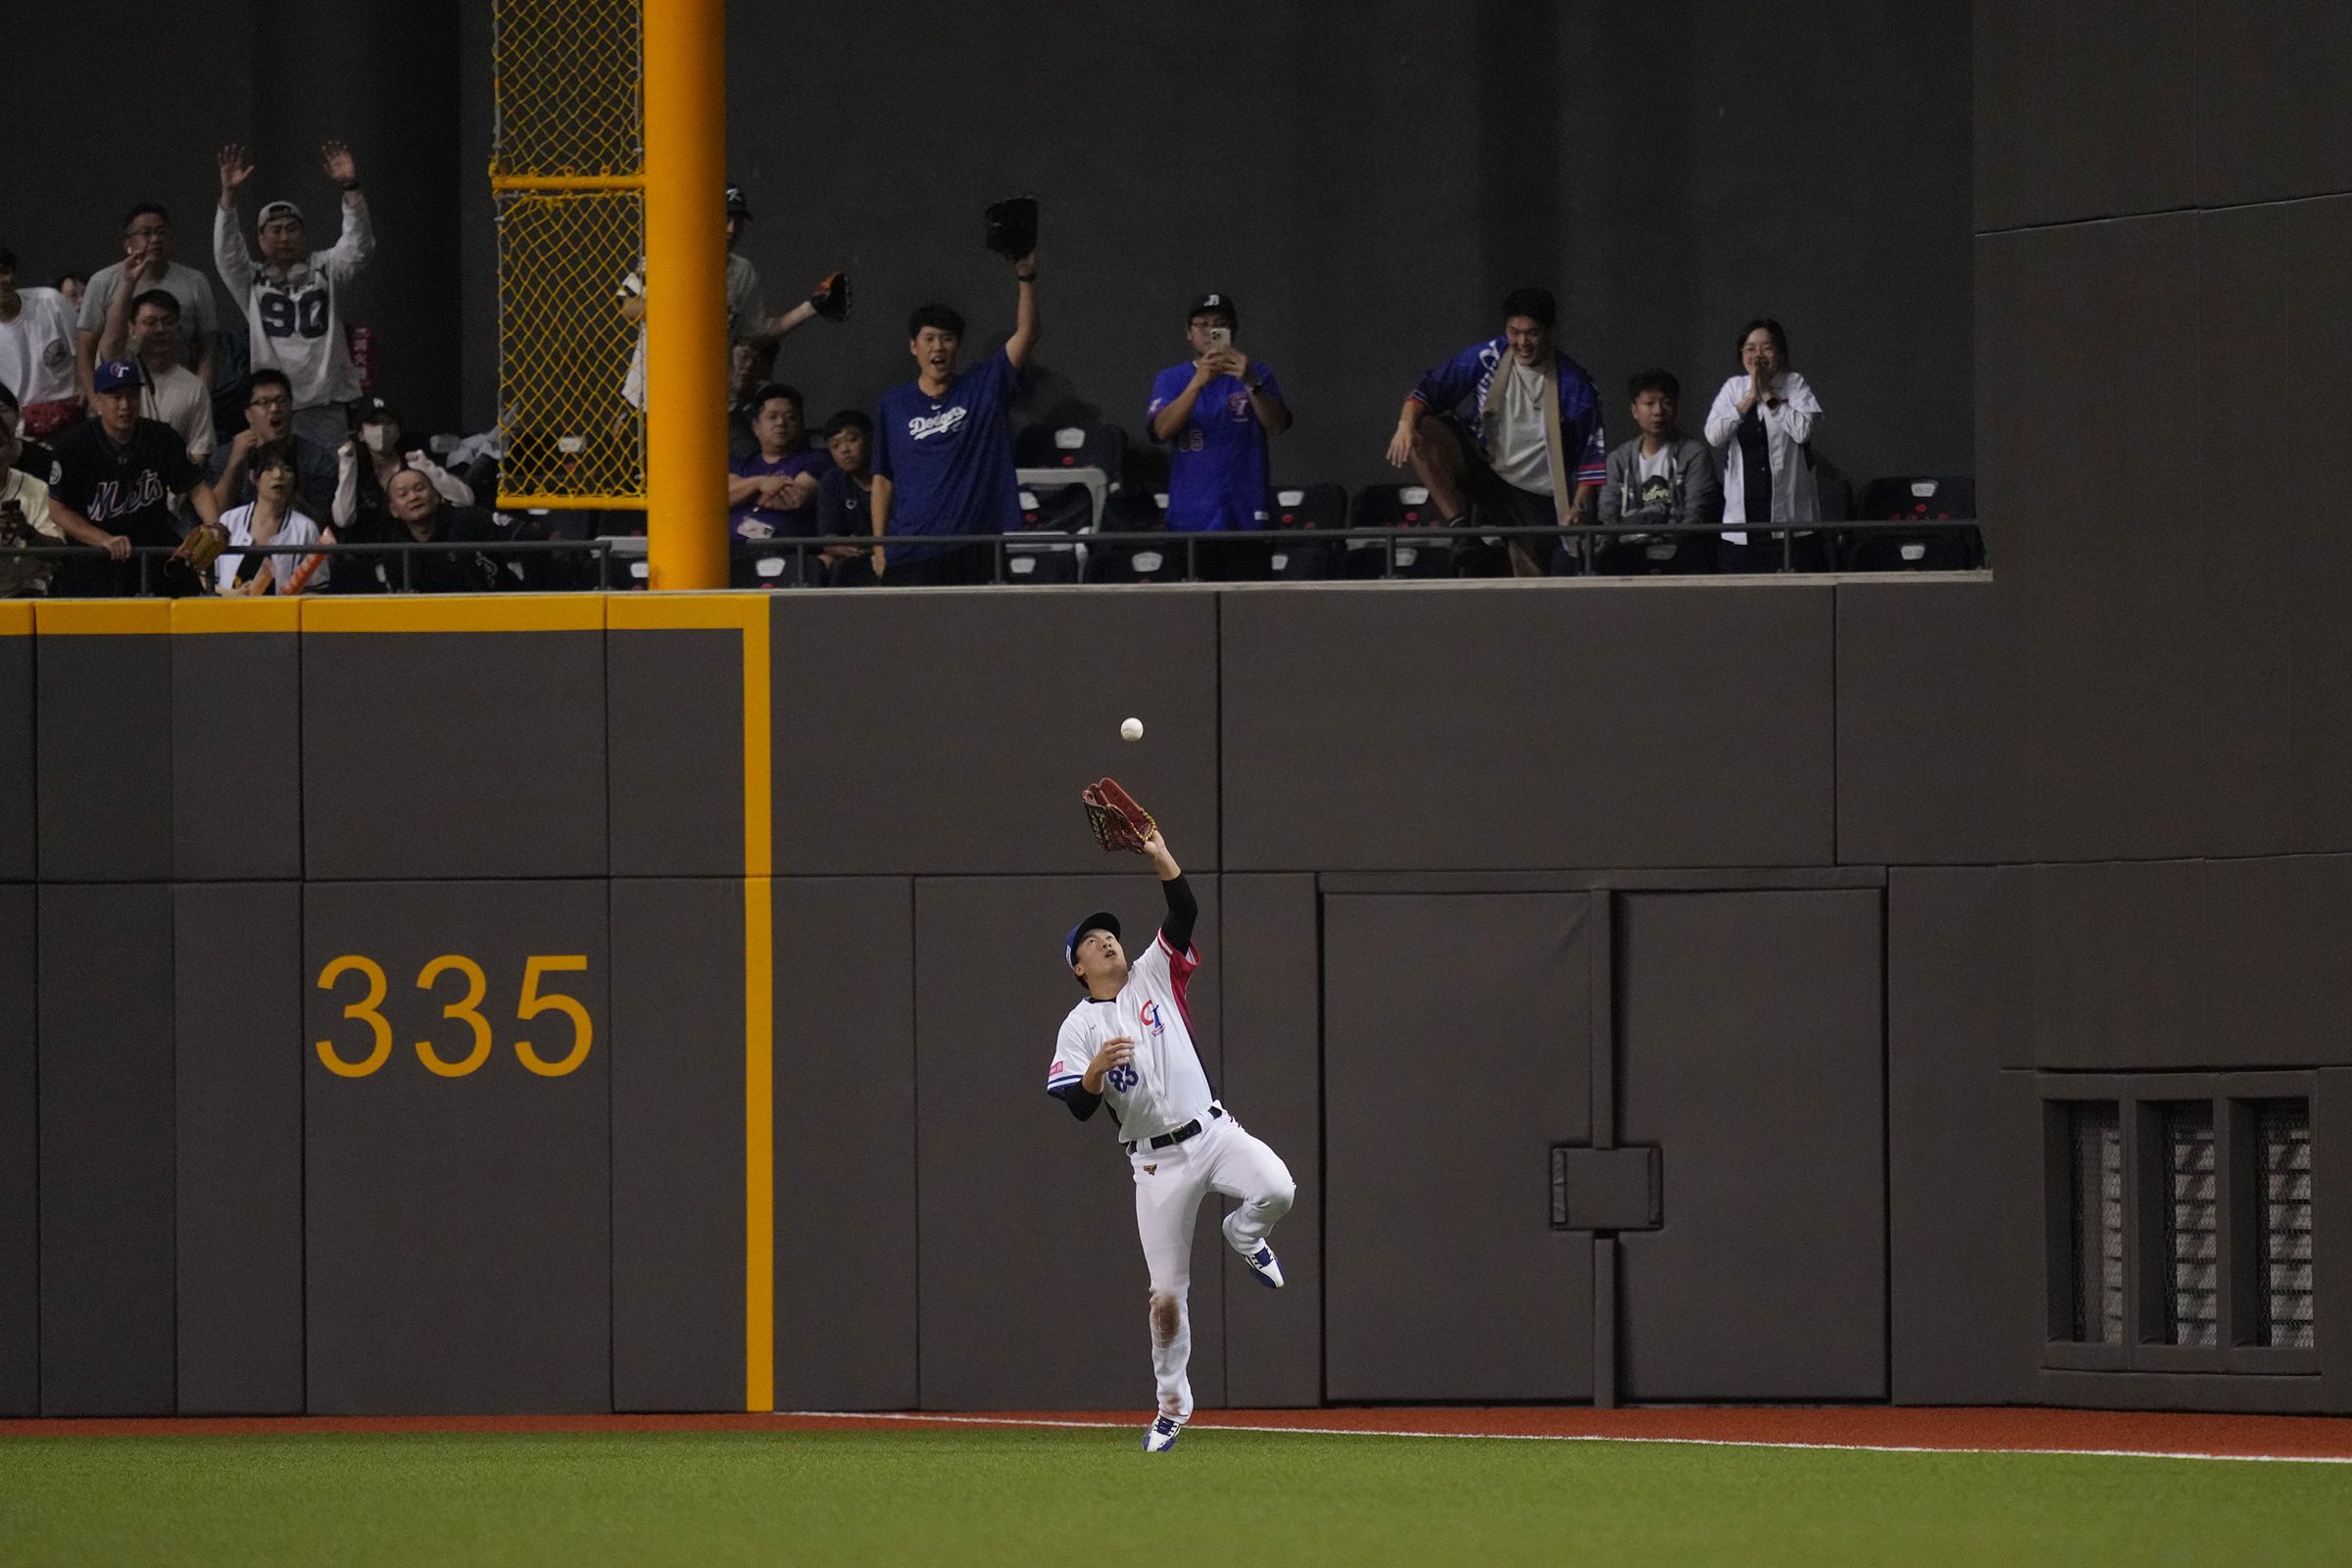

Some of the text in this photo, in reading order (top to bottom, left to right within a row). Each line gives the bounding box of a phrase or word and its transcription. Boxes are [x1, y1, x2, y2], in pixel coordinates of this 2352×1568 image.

[261, 289, 329, 339] 90
[908, 407, 967, 440] Dodgers
[87, 469, 164, 521] Mets
[316, 955, 593, 1077] 335
[1107, 1062, 1139, 1094] 83
